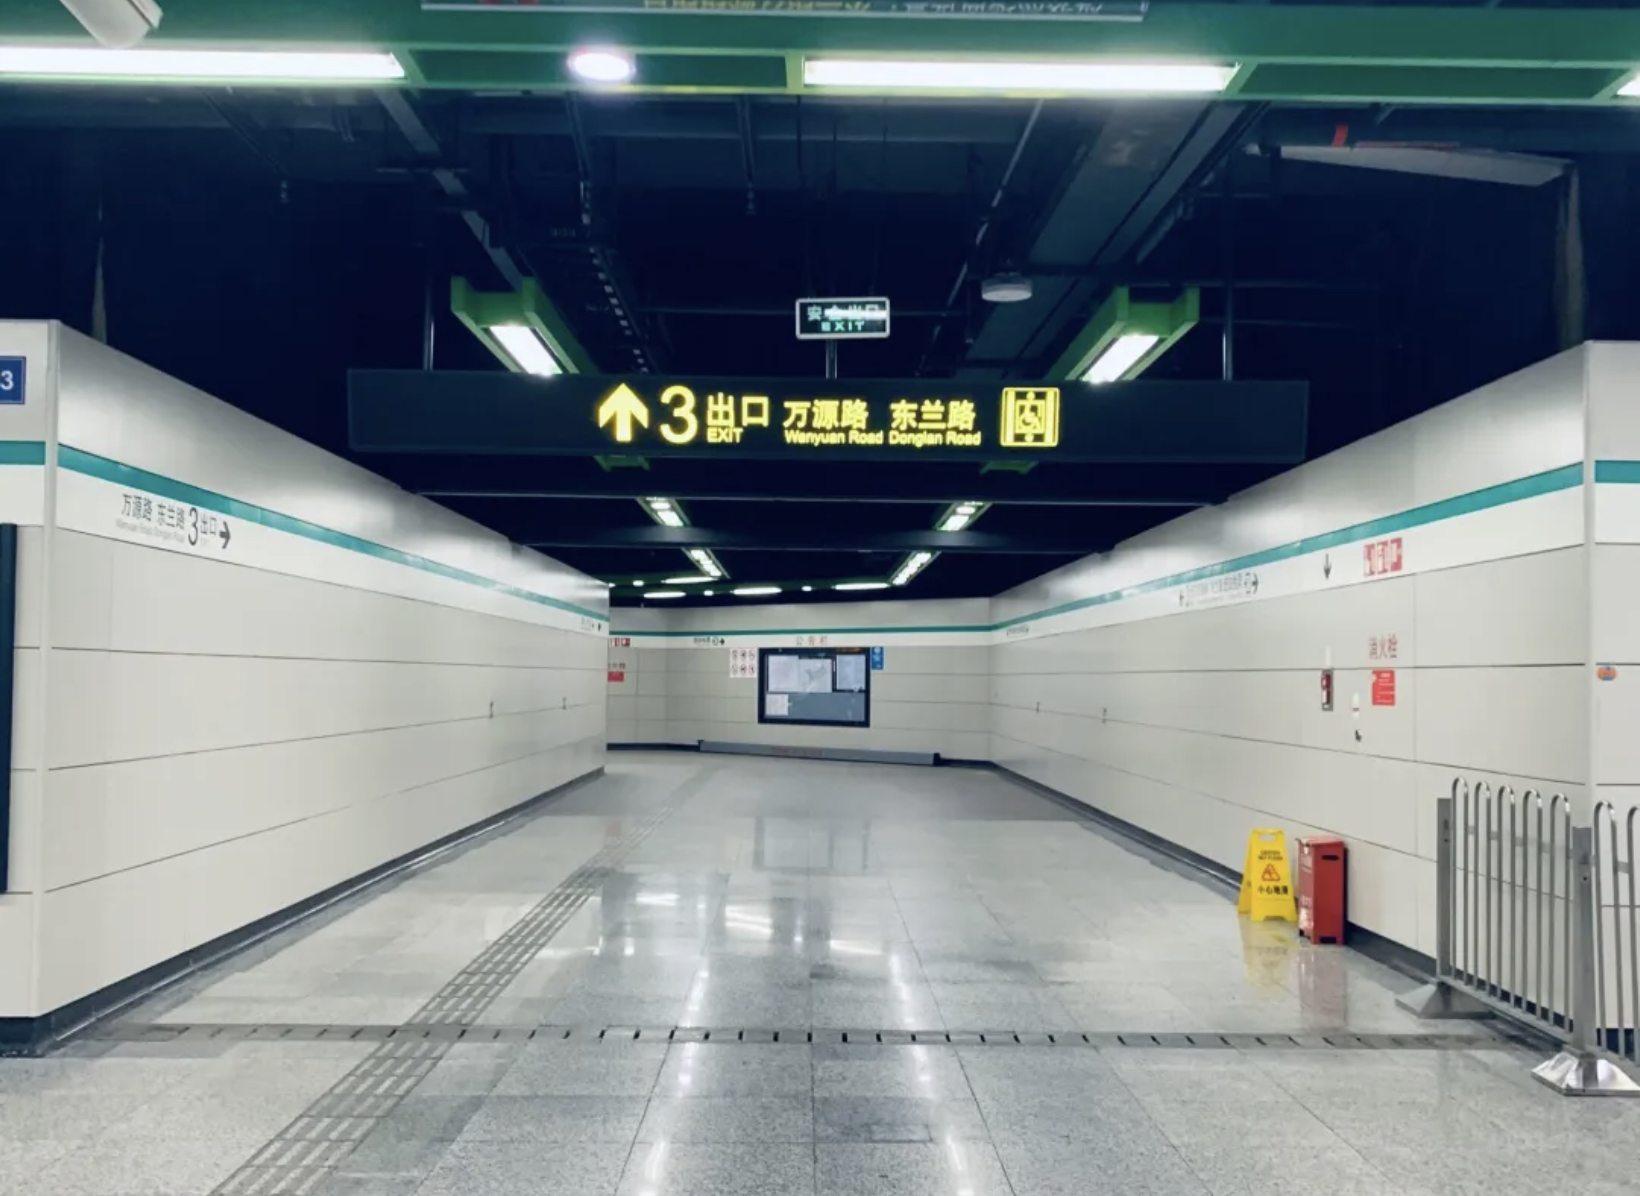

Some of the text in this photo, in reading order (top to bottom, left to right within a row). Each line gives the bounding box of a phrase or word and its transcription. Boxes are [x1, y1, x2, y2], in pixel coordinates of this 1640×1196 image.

[821, 321, 865, 332] EXIT
[0, 370, 14, 390] 3
[660, 384, 976, 444] 3 出口 万源路 东兰路
[707, 427, 744, 443] EXIT
[785, 429, 981, 448] Wanyuan Road Donglan Road
[188, 507, 199, 546] 3
[201, 514, 217, 536] 出口
